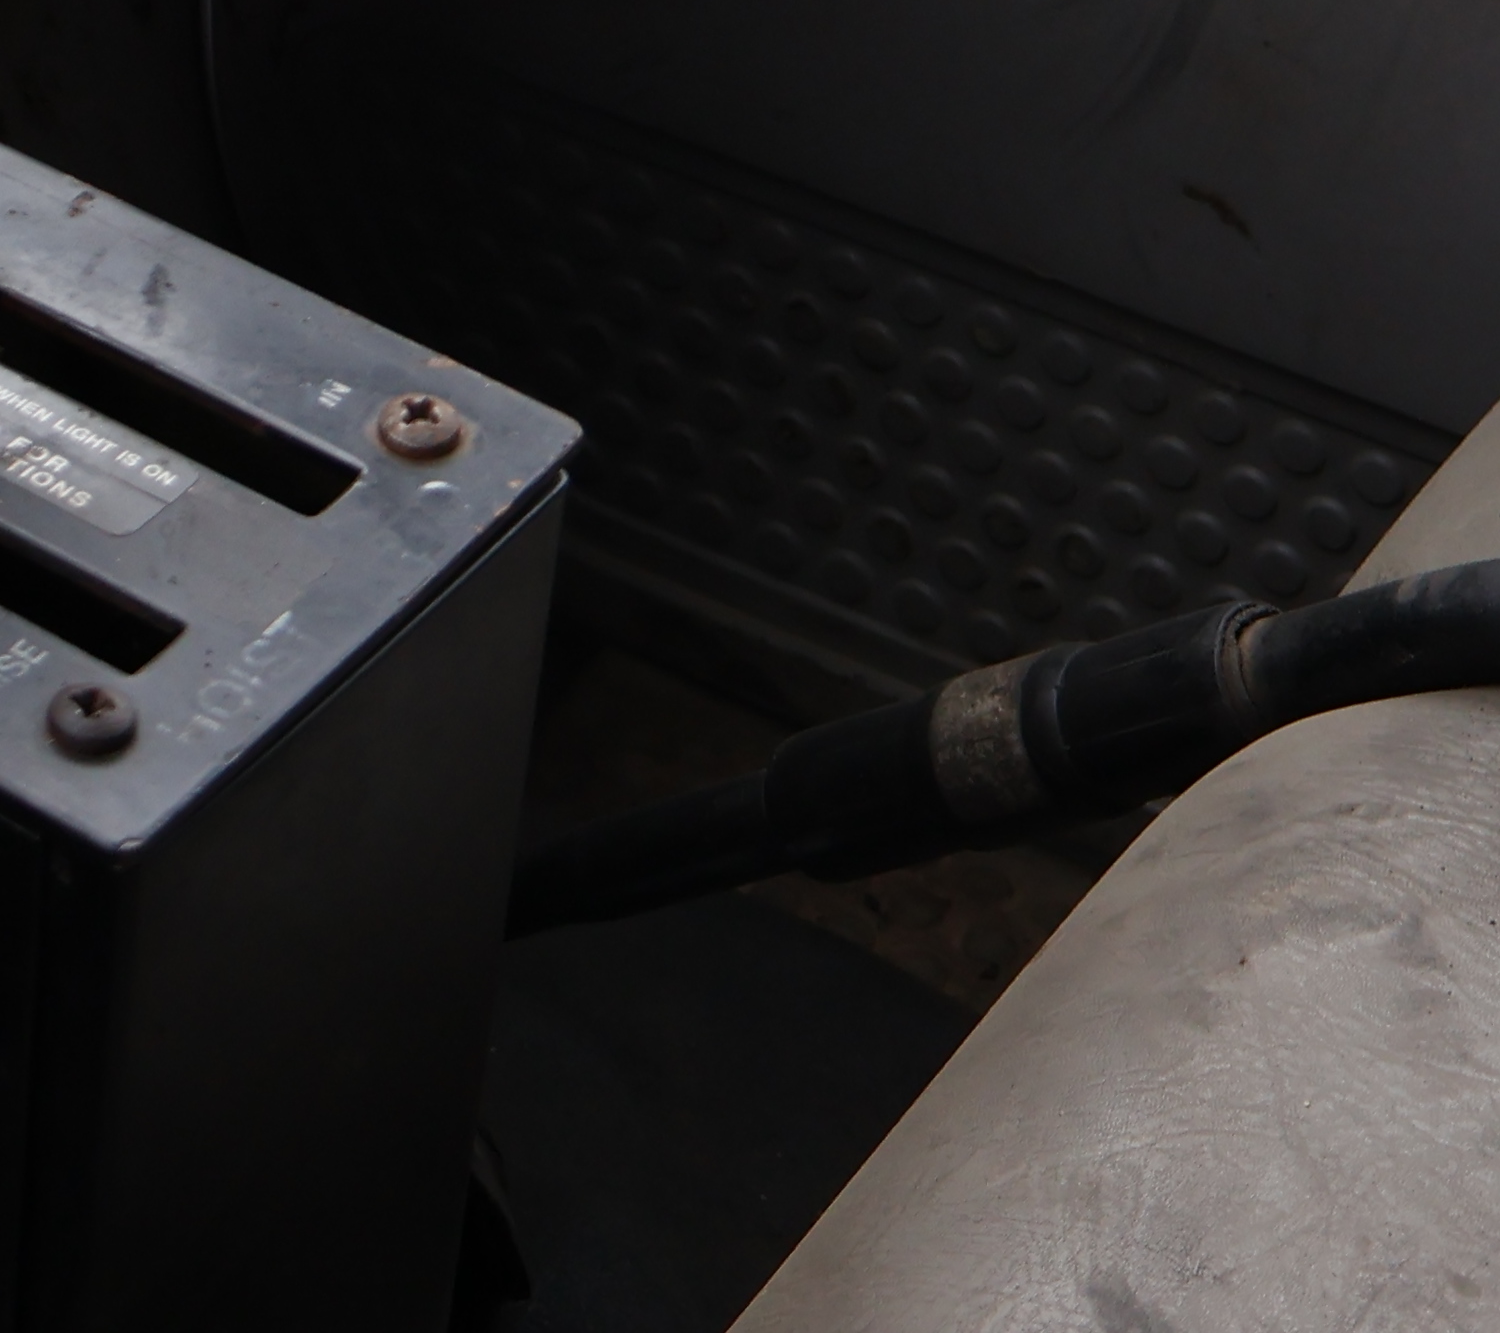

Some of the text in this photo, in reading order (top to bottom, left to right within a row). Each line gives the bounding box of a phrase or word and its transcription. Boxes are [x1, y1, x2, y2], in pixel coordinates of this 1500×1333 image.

[7, 434, 70, 473] FOR
[53, 417, 119, 455] LIGHT
[114, 449, 142, 468] IS
[141, 462, 178, 487] ON
